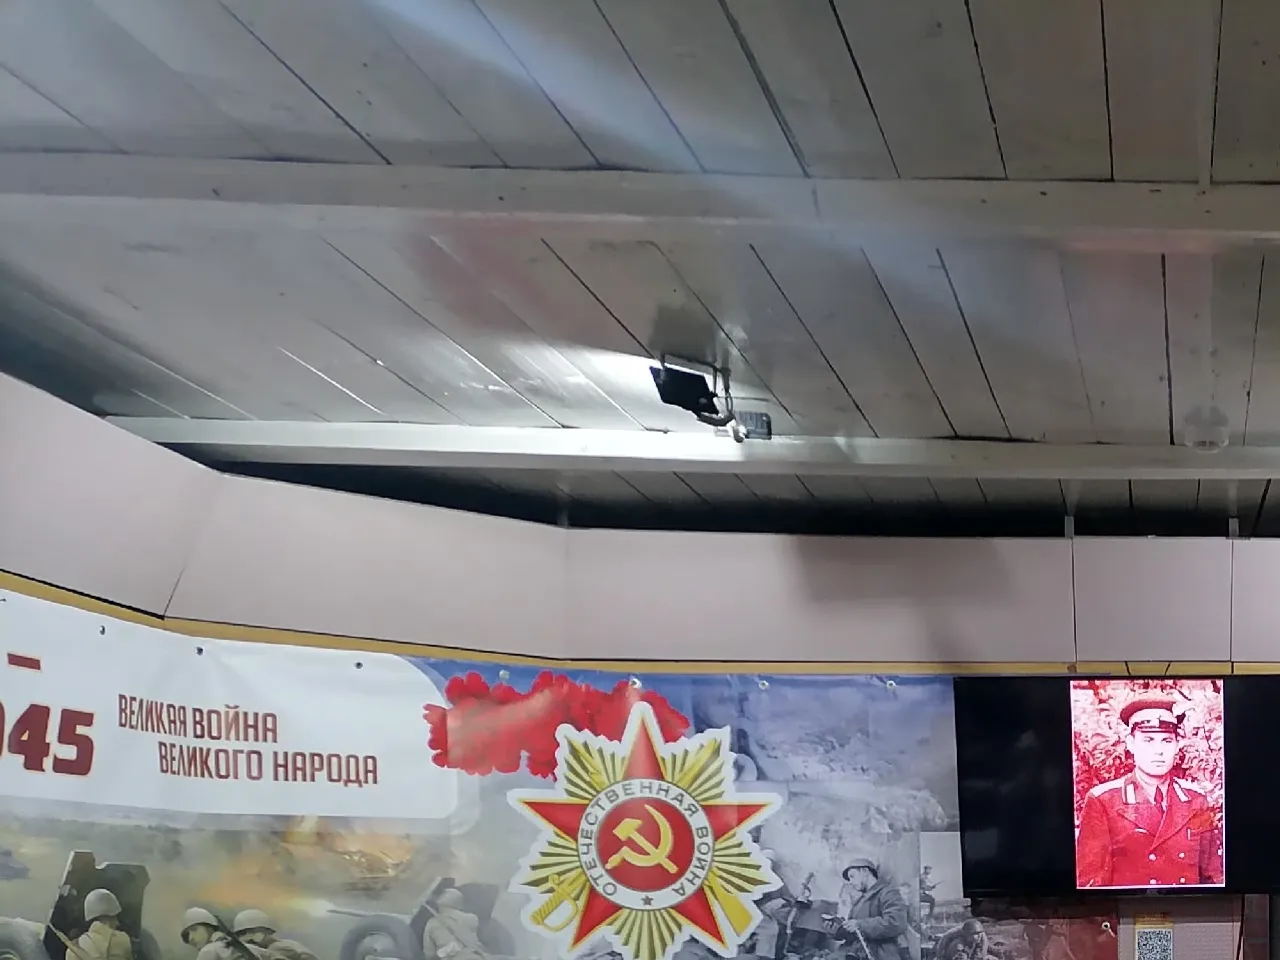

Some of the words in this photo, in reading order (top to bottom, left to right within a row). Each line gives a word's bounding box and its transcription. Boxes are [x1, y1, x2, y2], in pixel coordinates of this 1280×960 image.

[0, 703, 94, 776] 45
[118, 694, 187, 738] ВЕЛИКАЯ
[192, 704, 278, 743] ВОЙНА
[158, 741, 263, 781] ВЕЛИКОГО
[273, 751, 378, 787] НАРОДА
[580, 781, 699, 897] ОТЕЧЕСТВЕННАЯ
